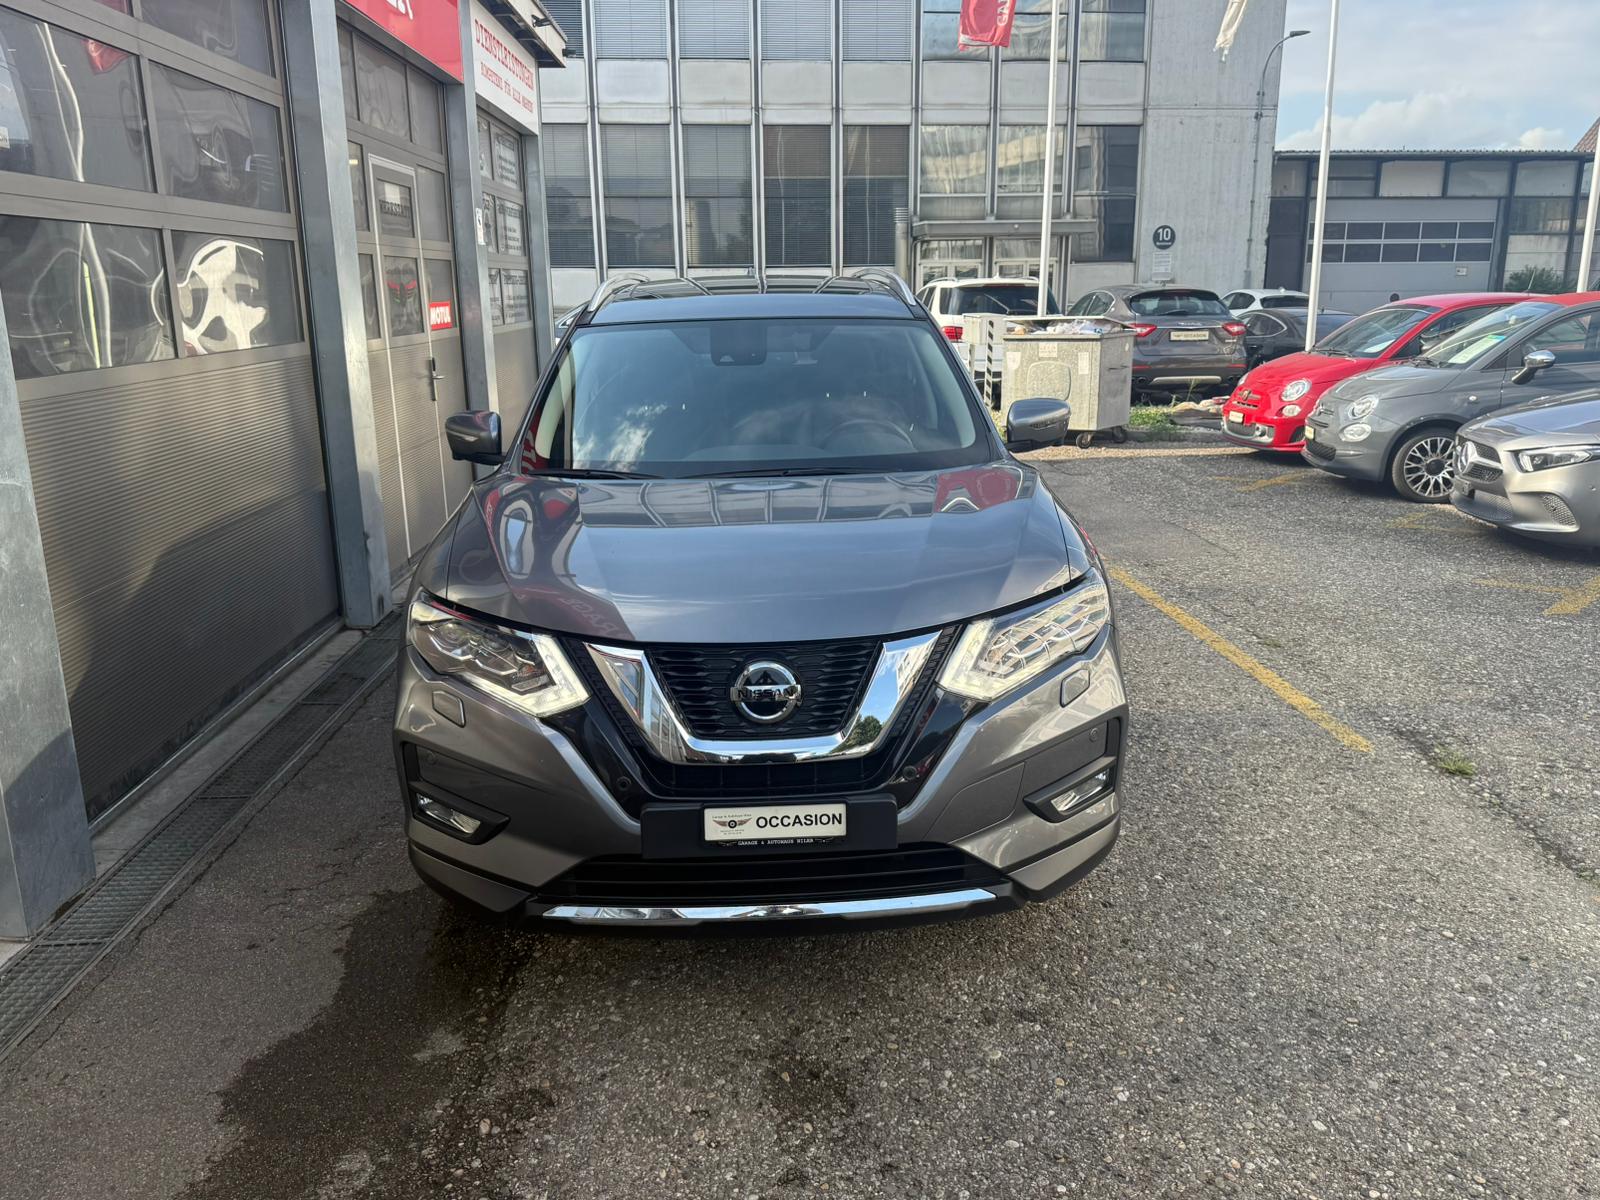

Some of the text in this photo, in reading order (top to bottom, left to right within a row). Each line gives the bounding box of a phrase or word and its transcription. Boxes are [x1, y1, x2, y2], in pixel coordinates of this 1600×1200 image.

[1157, 228, 1171, 241] 10
[430, 306, 451, 325] MOTUL
[737, 687, 799, 699] NISSAN
[756, 813, 842, 829] OCCASION
